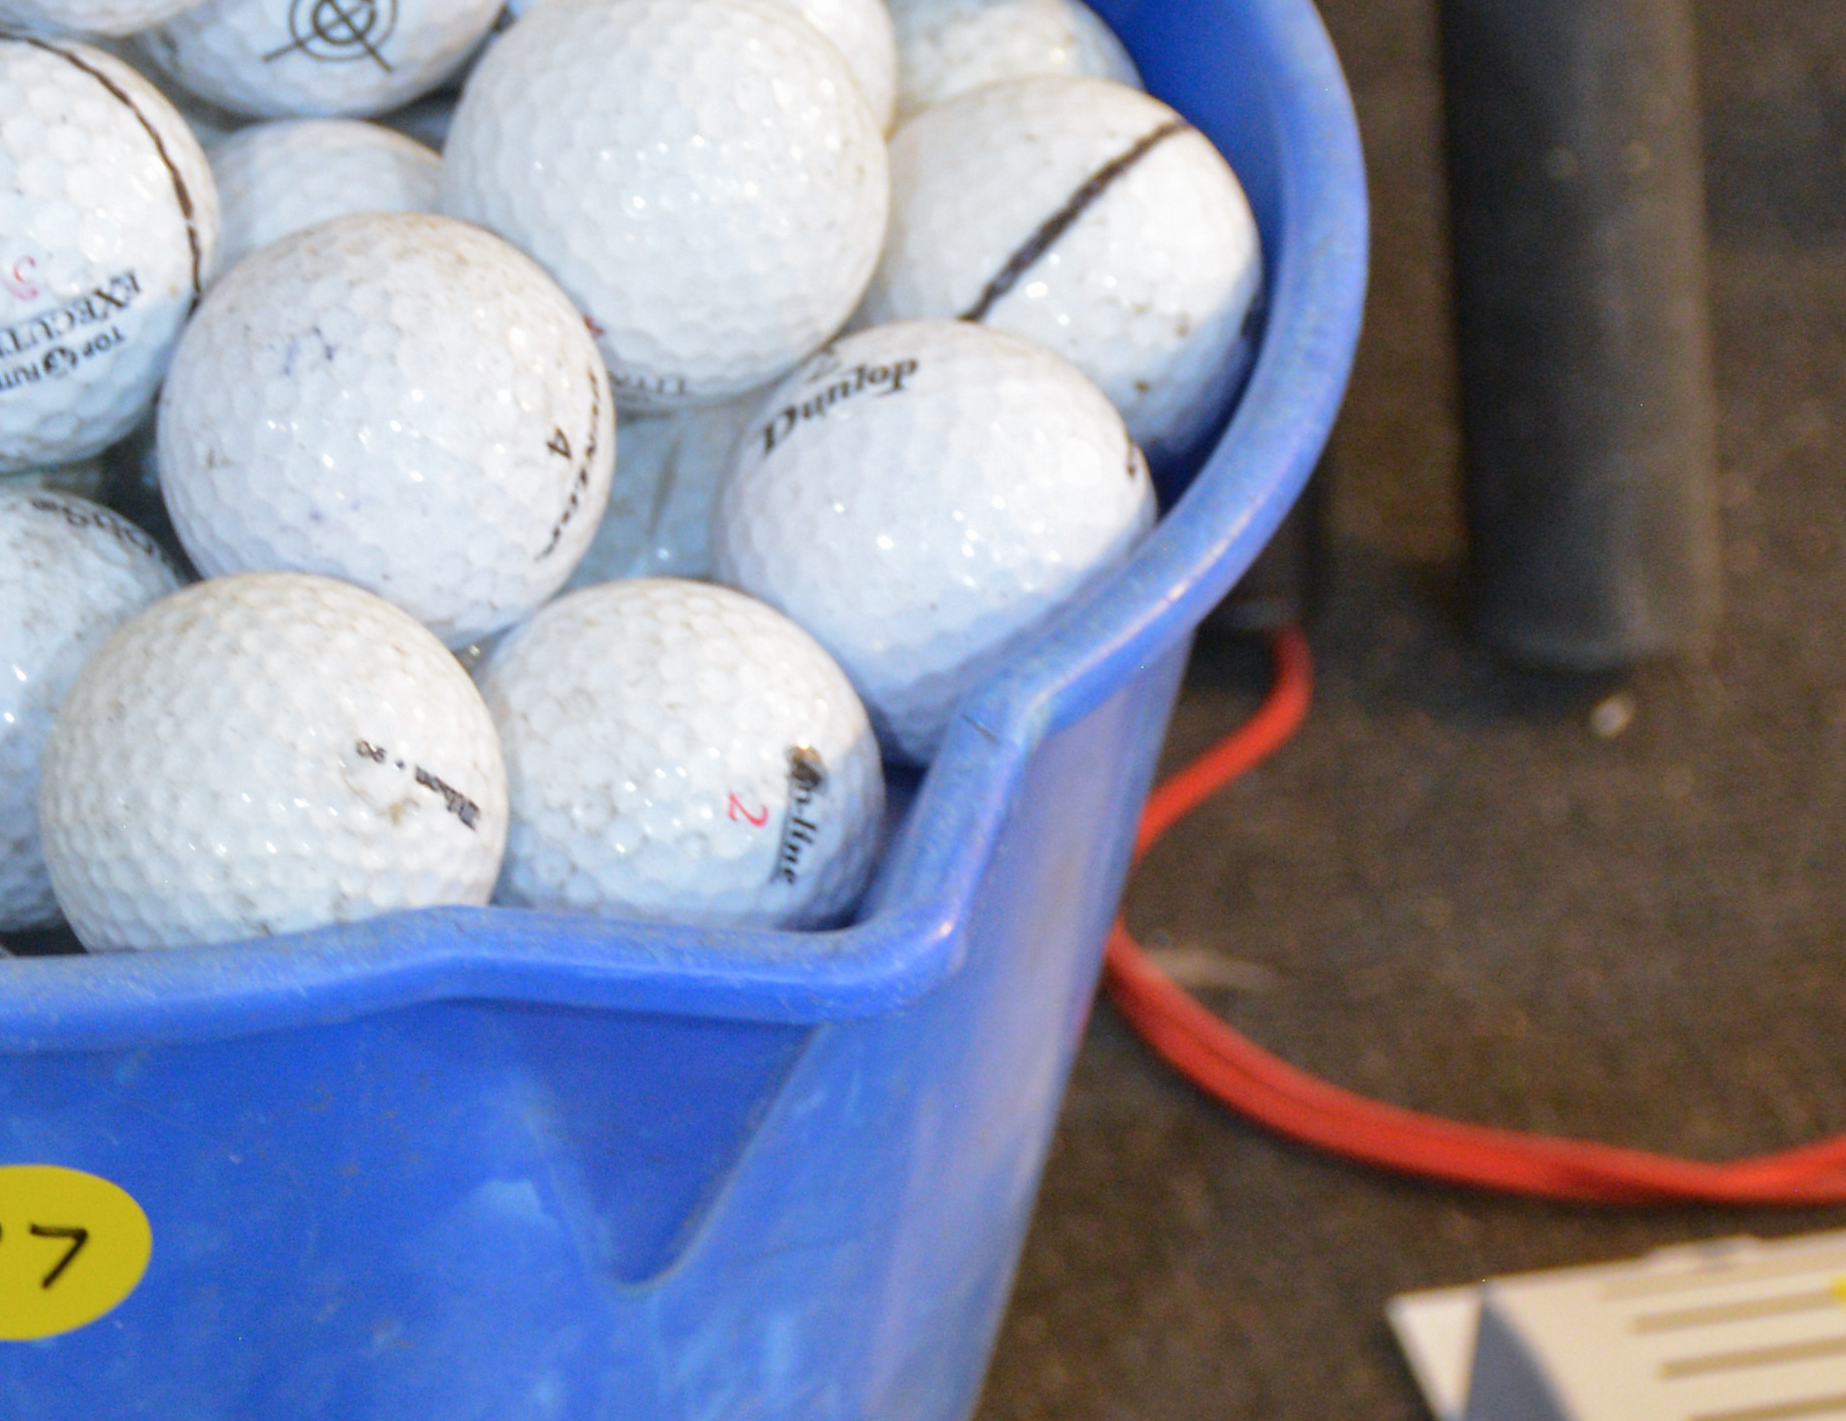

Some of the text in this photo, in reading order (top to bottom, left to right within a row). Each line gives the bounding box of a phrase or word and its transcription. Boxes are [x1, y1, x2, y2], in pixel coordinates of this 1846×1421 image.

[82, 326, 126, 360] TOP
[762, 357, 919, 455] Dunlop
[728, 790, 768, 827] 2
